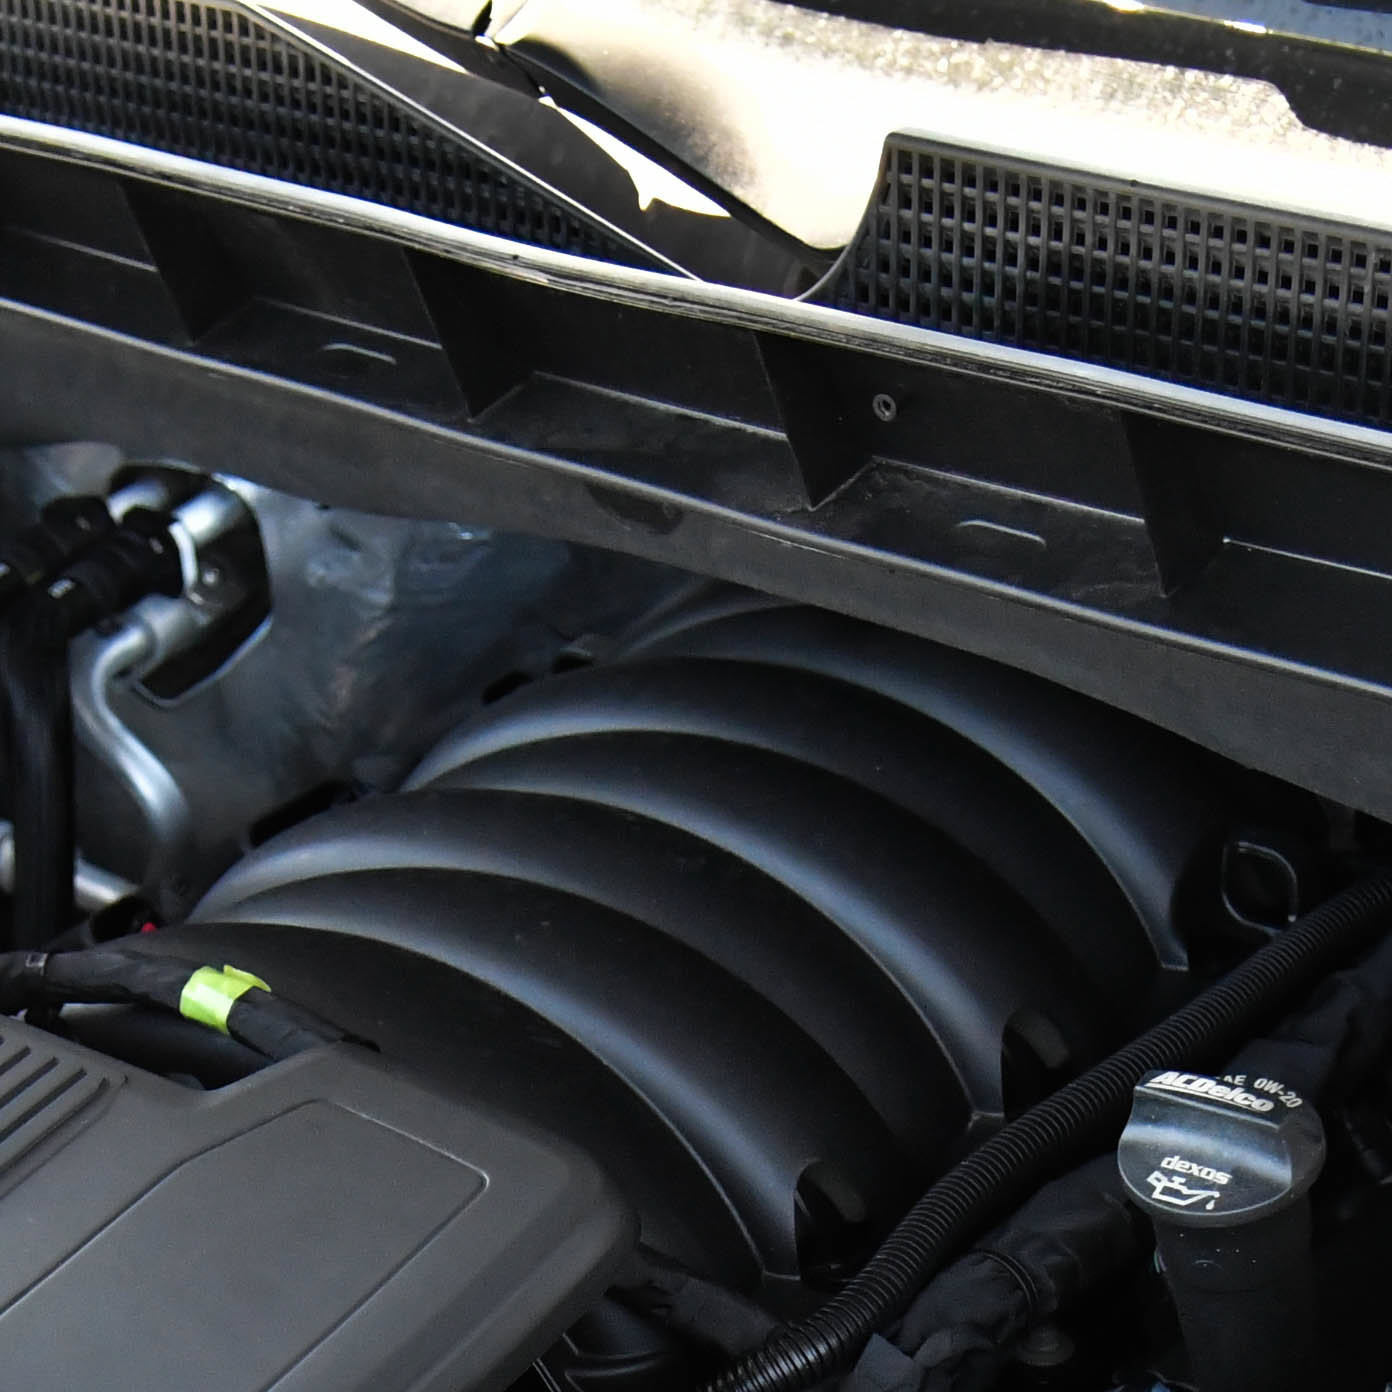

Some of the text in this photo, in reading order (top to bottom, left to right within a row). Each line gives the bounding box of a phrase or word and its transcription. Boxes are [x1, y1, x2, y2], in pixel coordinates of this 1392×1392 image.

[1148, 1071, 1275, 1112] ACDelco
[1216, 1074, 1303, 1109] AE 0W-20
[1160, 1155, 1233, 1186] dexos
